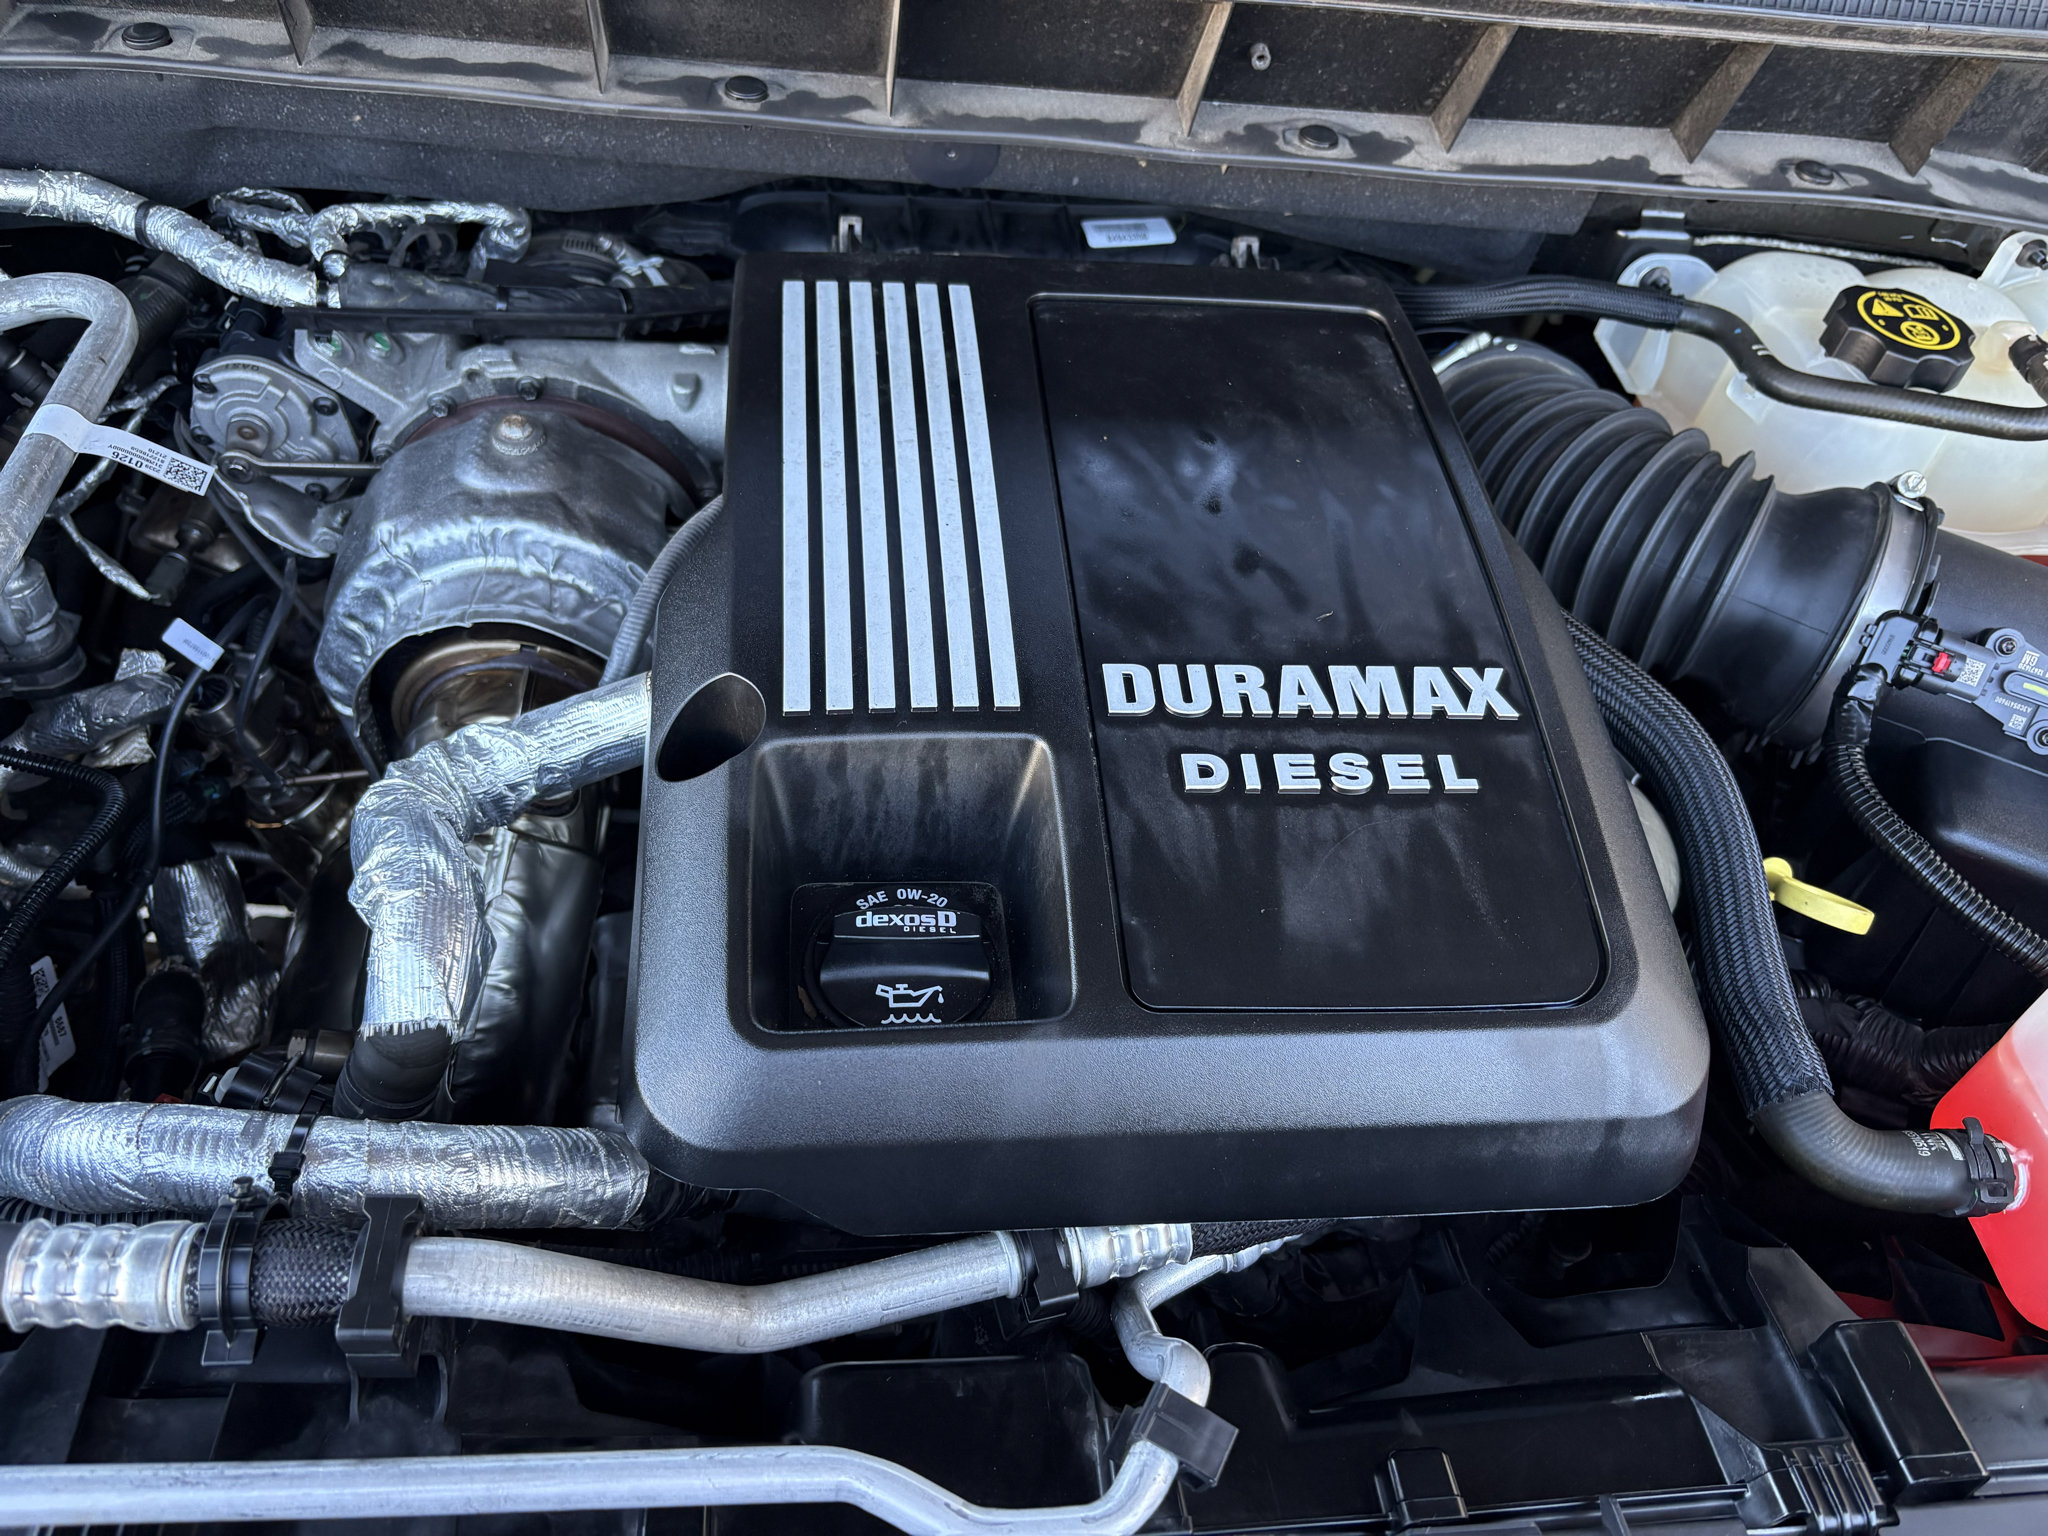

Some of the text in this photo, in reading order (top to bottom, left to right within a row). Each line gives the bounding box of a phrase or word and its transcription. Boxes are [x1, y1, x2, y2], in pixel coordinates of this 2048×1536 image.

[111, 451, 144, 469] 0126
[2021, 651, 2040, 667] GM
[1102, 663, 1519, 720] DURAMAX
[1180, 752, 1480, 795] DIESEL
[856, 888, 948, 910] SAE 0W-20
[855, 911, 957, 928] dexosD
[903, 926, 957, 934] DIESEL
